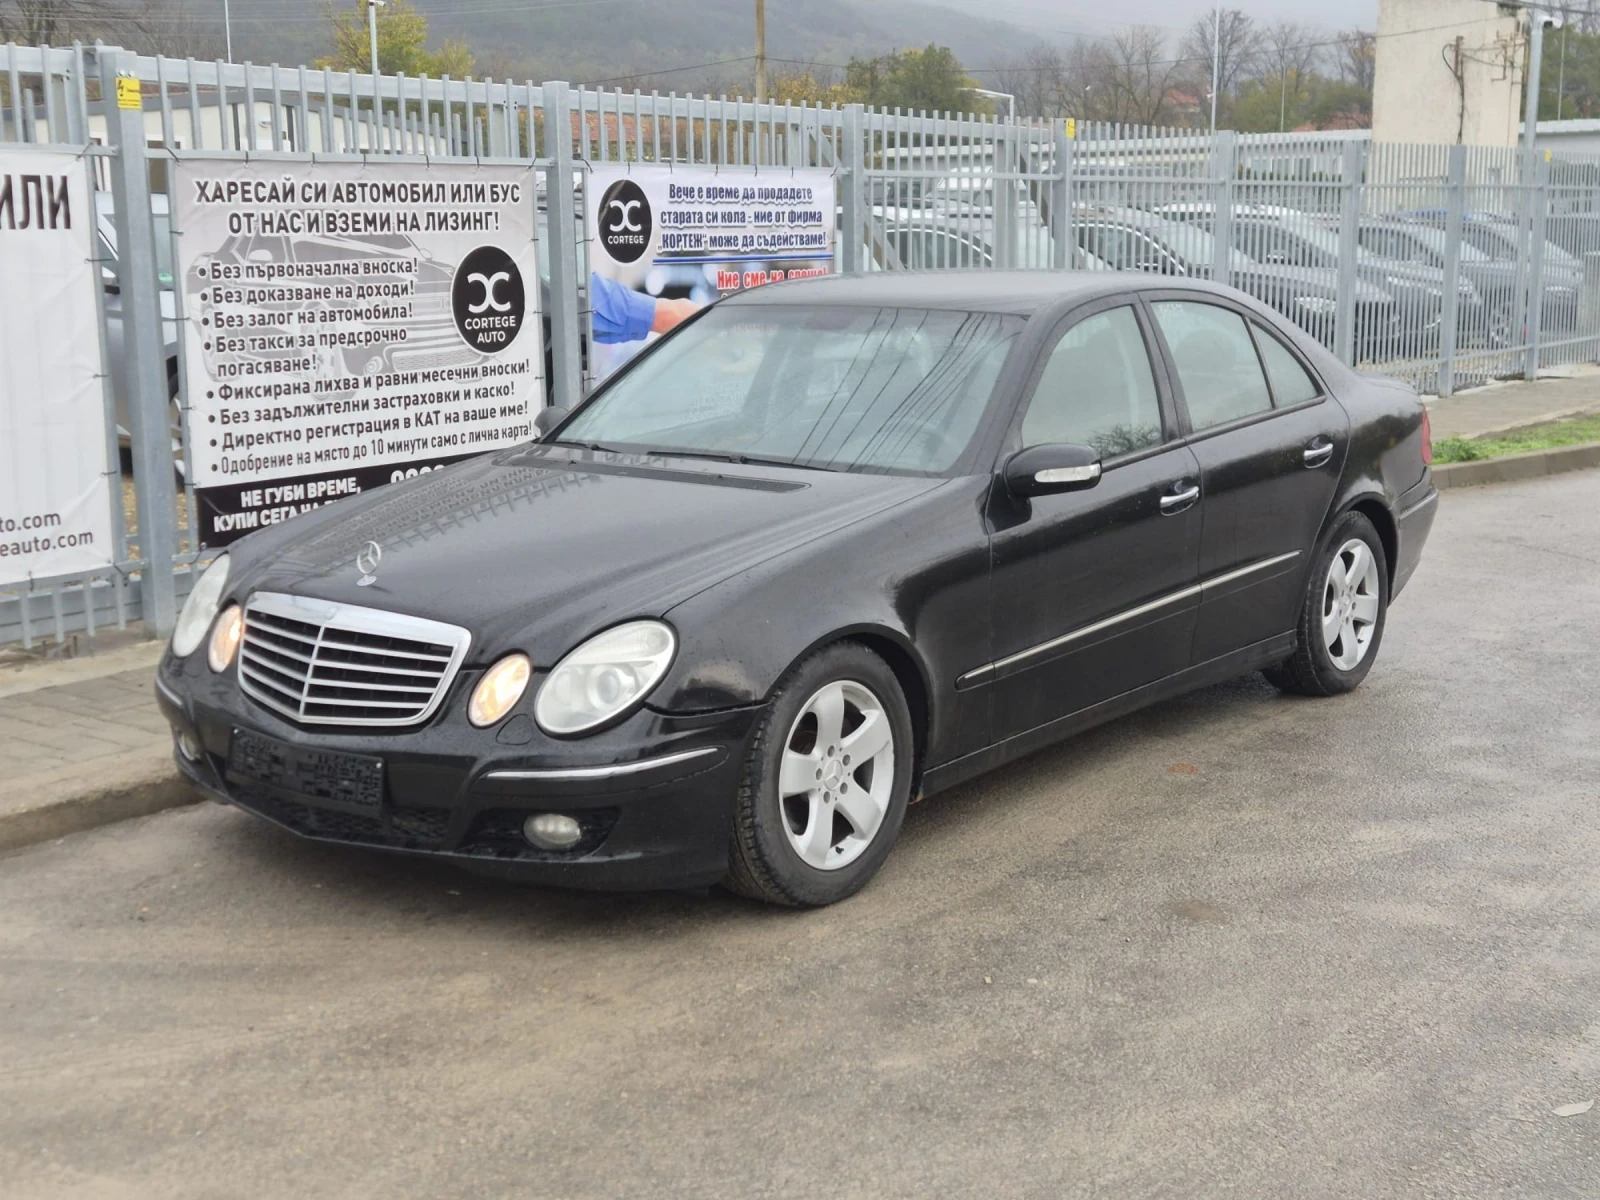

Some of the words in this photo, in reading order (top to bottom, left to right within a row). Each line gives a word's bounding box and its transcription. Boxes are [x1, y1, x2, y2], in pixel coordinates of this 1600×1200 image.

[196, 176, 296, 203] ХАРЕСАЙ
[301, 182, 327, 203] СИ
[332, 182, 445, 203] АВТОМОБИЛ
[451, 183, 486, 203] ИЛИ
[490, 183, 521, 203] БУС
[669, 184, 695, 199] Вече
[698, 187, 704, 199] е
[706, 187, 739, 201] време
[742, 187, 756, 201] да
[758, 187, 813, 201] продадете
[229, 213, 254, 234] ОТ
[261, 213, 301, 234] НАС
[307, 213, 320, 234] И
[326, 213, 392, 233] ВЗЕМИ
[397, 213, 421, 232] НА
[425, 211, 499, 232] ЛИЗИНГ!
[660, 211, 704, 225] старата
[706, 211, 718, 223] си
[721, 211, 746, 223] кола
[754, 211, 773, 223] ние
[775, 211, 785, 223] от
[788, 209, 823, 224] фирма
[607, 235, 645, 245] CORTEGE
[710, 235, 739, 248] може
[742, 235, 755, 248] да
[757, 231, 826, 248] съдействаме!
[211, 262, 241, 280] Без
[246, 262, 360, 281] първоначална
[363, 257, 418, 275] вноска!
[717, 270, 739, 289] Ние
[744, 271, 766, 288] сме
[213, 287, 243, 304] Без
[247, 286, 332, 305] доказване
[336, 285, 353, 299] на
[356, 280, 414, 300] доходи!
[214, 311, 244, 329] Без
[248, 312, 294, 327] залог
[298, 310, 315, 324] на
[319, 302, 413, 323] автомобила!
[464, 316, 516, 330] CORTEGE
[216, 335, 246, 353] Без
[249, 335, 295, 351] такси
[298, 335, 315, 348] за
[319, 328, 407, 349] предсрочно
[477, 331, 506, 343] AUTO
[218, 354, 317, 377] погасяване!
[218, 380, 310, 401] Фиксирана
[314, 376, 360, 393] лихва
[363, 375, 372, 389] и
[376, 373, 419, 391] равни
[421, 367, 479, 383] месечни
[481, 358, 530, 377] вноски!
[220, 408, 250, 425] Без
[254, 398, 370, 422] задължителни
[373, 388, 461, 411] застраховки
[463, 388, 472, 401] и
[474, 381, 515, 400] каско!
[222, 428, 301, 452] Директно
[306, 418, 400, 443] регистрация
[403, 416, 411, 429] в
[414, 410, 441, 428] КАТ
[444, 411, 460, 425] на
[463, 403, 497, 422] ваше
[499, 400, 529, 418] име!
[221, 453, 294, 475] Одобрение
[296, 449, 311, 465] на
[314, 445, 350, 463] място
[352, 443, 368, 461] до
[371, 438, 384, 456] 10
[387, 436, 429, 455] минути
[431, 432, 458, 449] само
[460, 432, 466, 445] с
[468, 426, 500, 444] лична
[501, 420, 533, 441] карта!
[241, 489, 263, 508] НЕ
[264, 483, 305, 504] ГУБИ
[307, 476, 362, 499] ВРЕМЕ,
[213, 510, 258, 533] КУПИ
[260, 504, 298, 526] СЕГА
[0, 531, 93, 557] eauto.com
